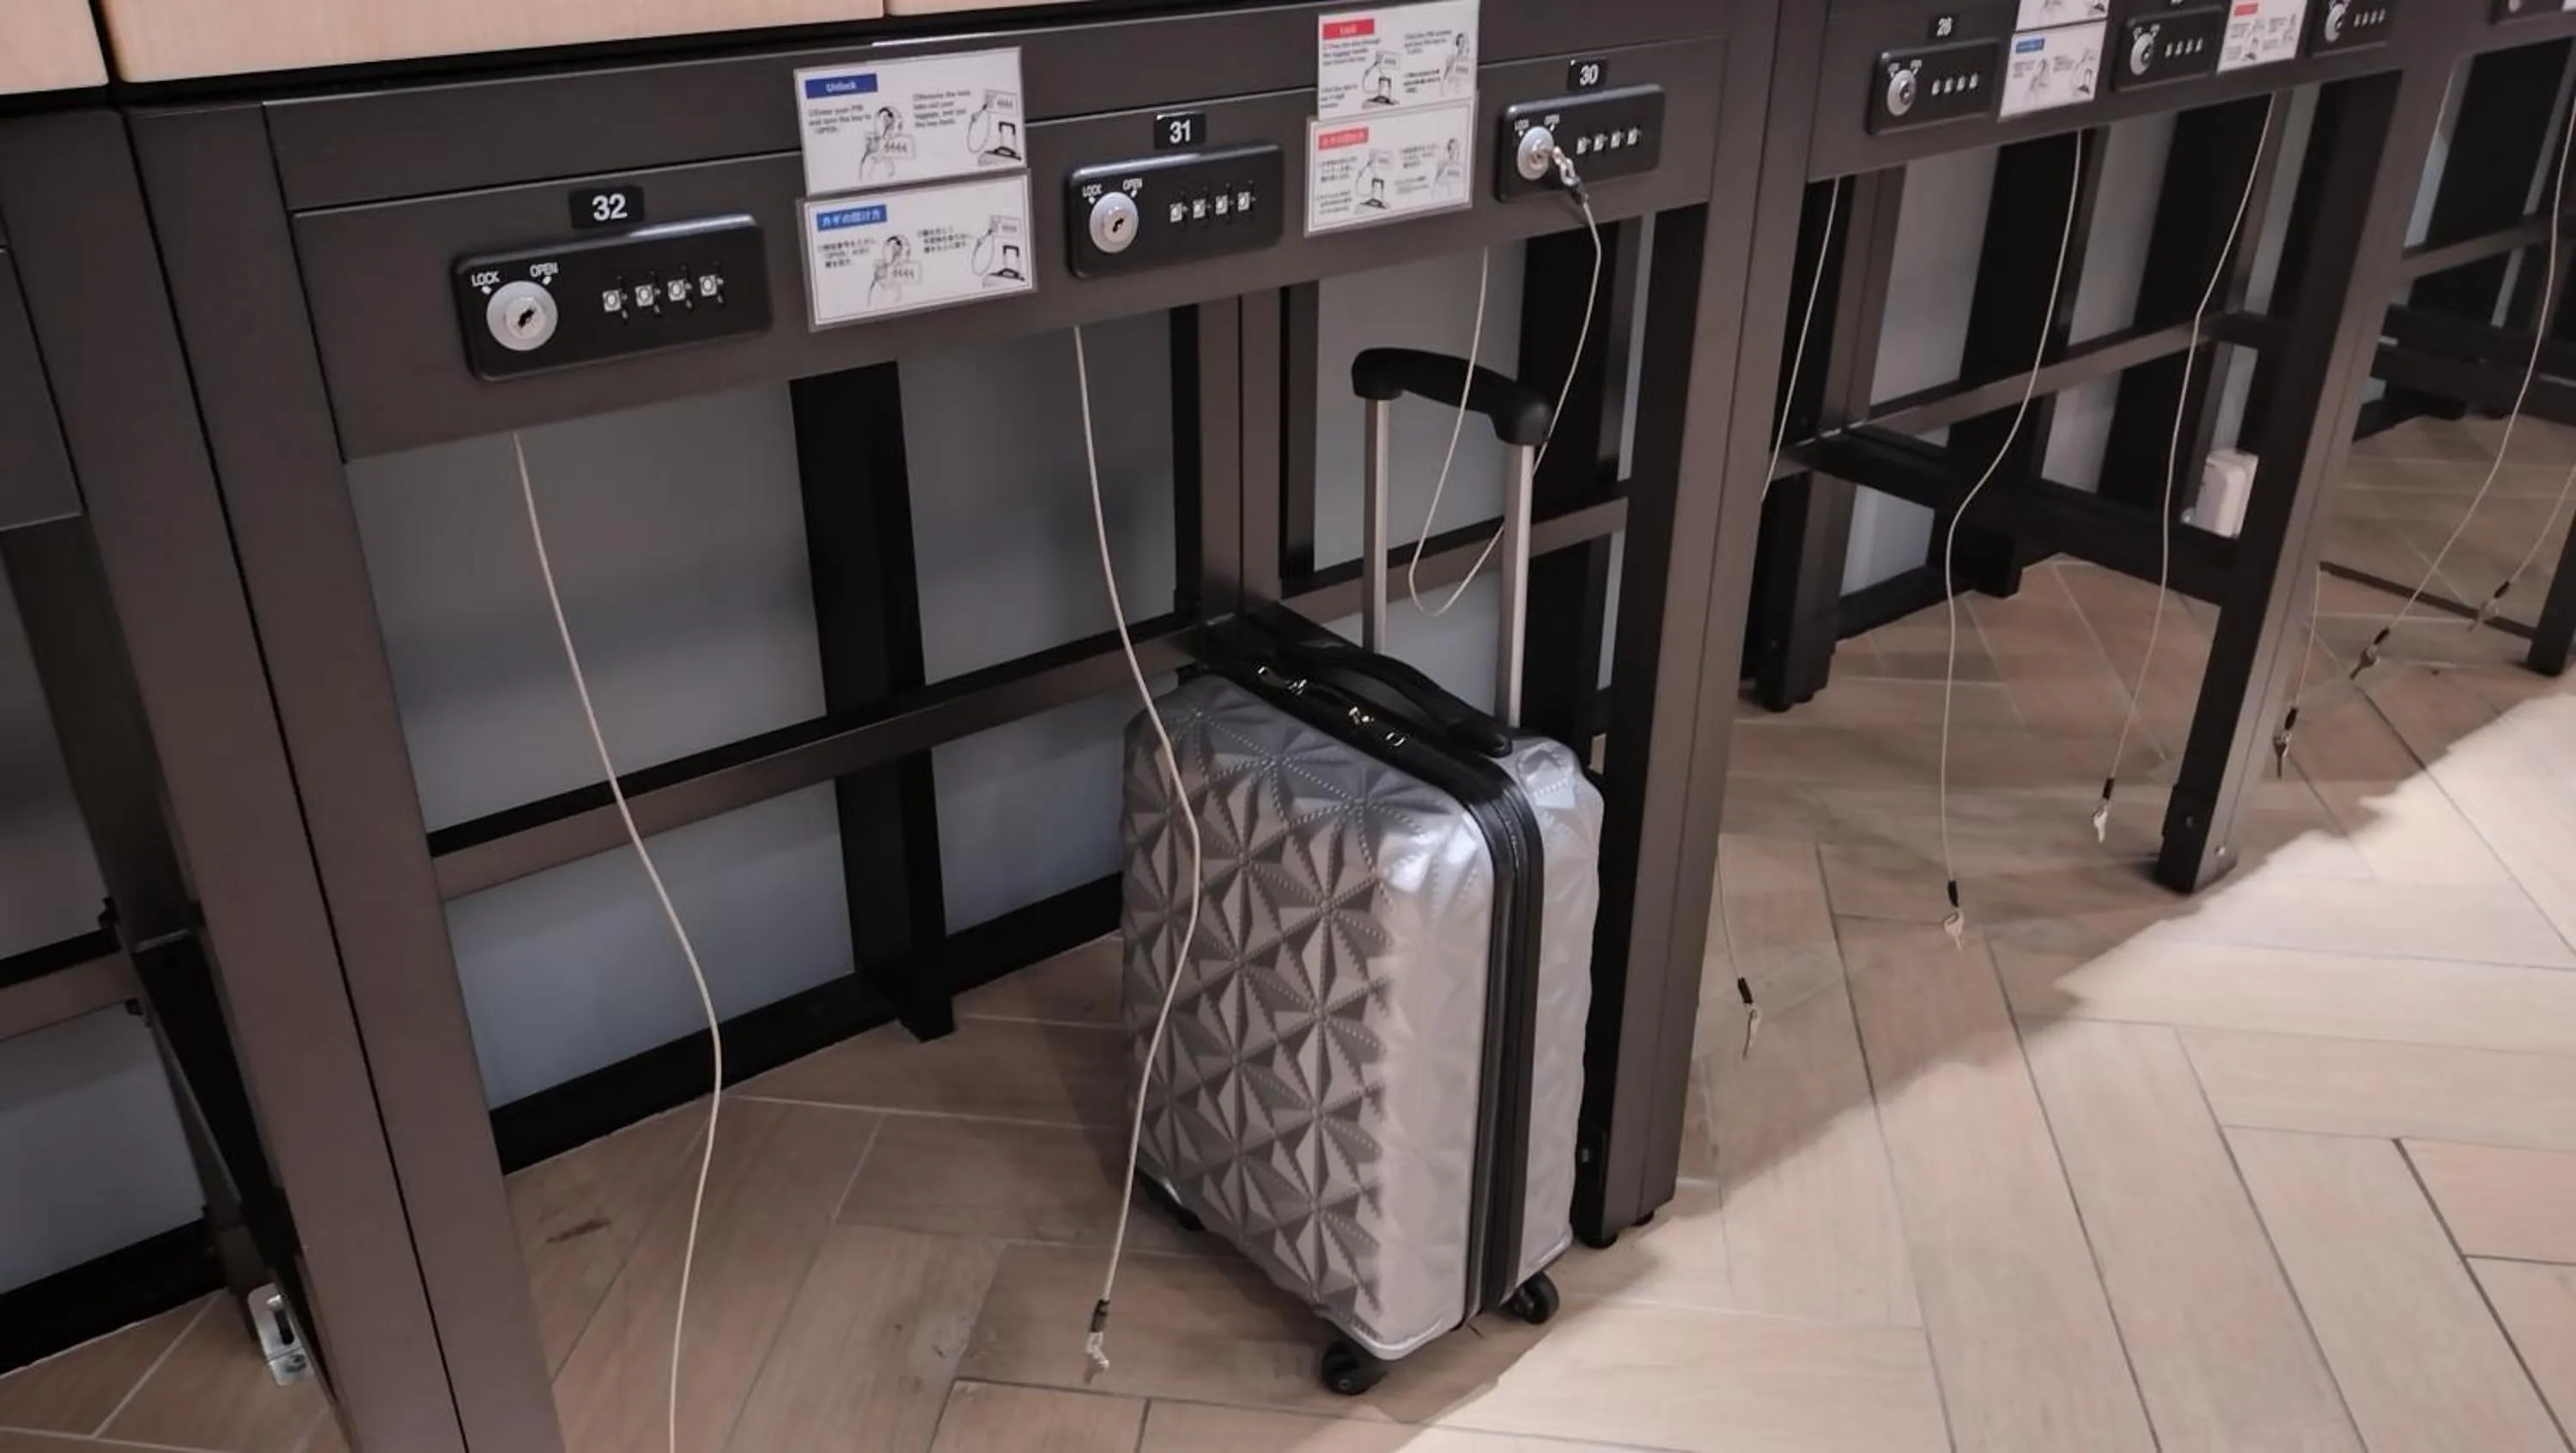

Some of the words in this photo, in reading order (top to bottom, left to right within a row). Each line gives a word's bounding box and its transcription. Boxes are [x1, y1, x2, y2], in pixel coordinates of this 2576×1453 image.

[1579, 64, 1600, 85] 30
[825, 80, 857, 94] Unlock
[1170, 119, 1191, 144] 31
[1082, 183, 1103, 198] LOCK
[1122, 177, 1143, 191] OPEN
[592, 192, 629, 222] 32
[471, 270, 501, 289] LOCK
[529, 261, 559, 279] OPEN
